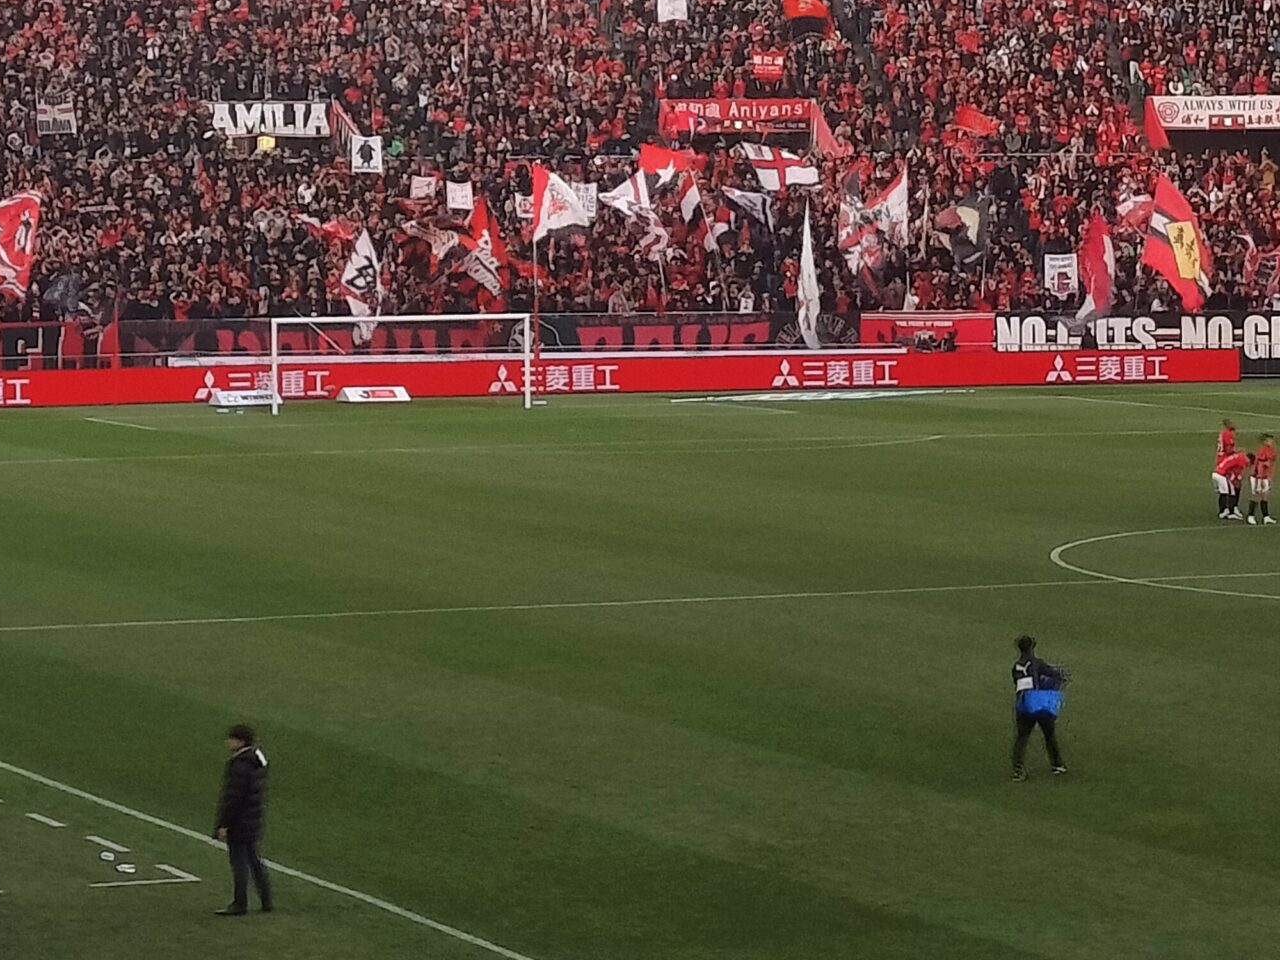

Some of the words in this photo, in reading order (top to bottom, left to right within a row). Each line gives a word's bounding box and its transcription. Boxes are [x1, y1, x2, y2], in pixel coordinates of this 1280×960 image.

[1182, 100, 1223, 110] ALWAYS
[1229, 100, 1256, 111] WITH
[1260, 100, 1273, 110] US
[1181, 316, 1233, 350] NO
[521, 364, 620, 392] 三菱重工
[802, 360, 898, 387] 三菱重工
[1075, 355, 1168, 382] 三菱重工
